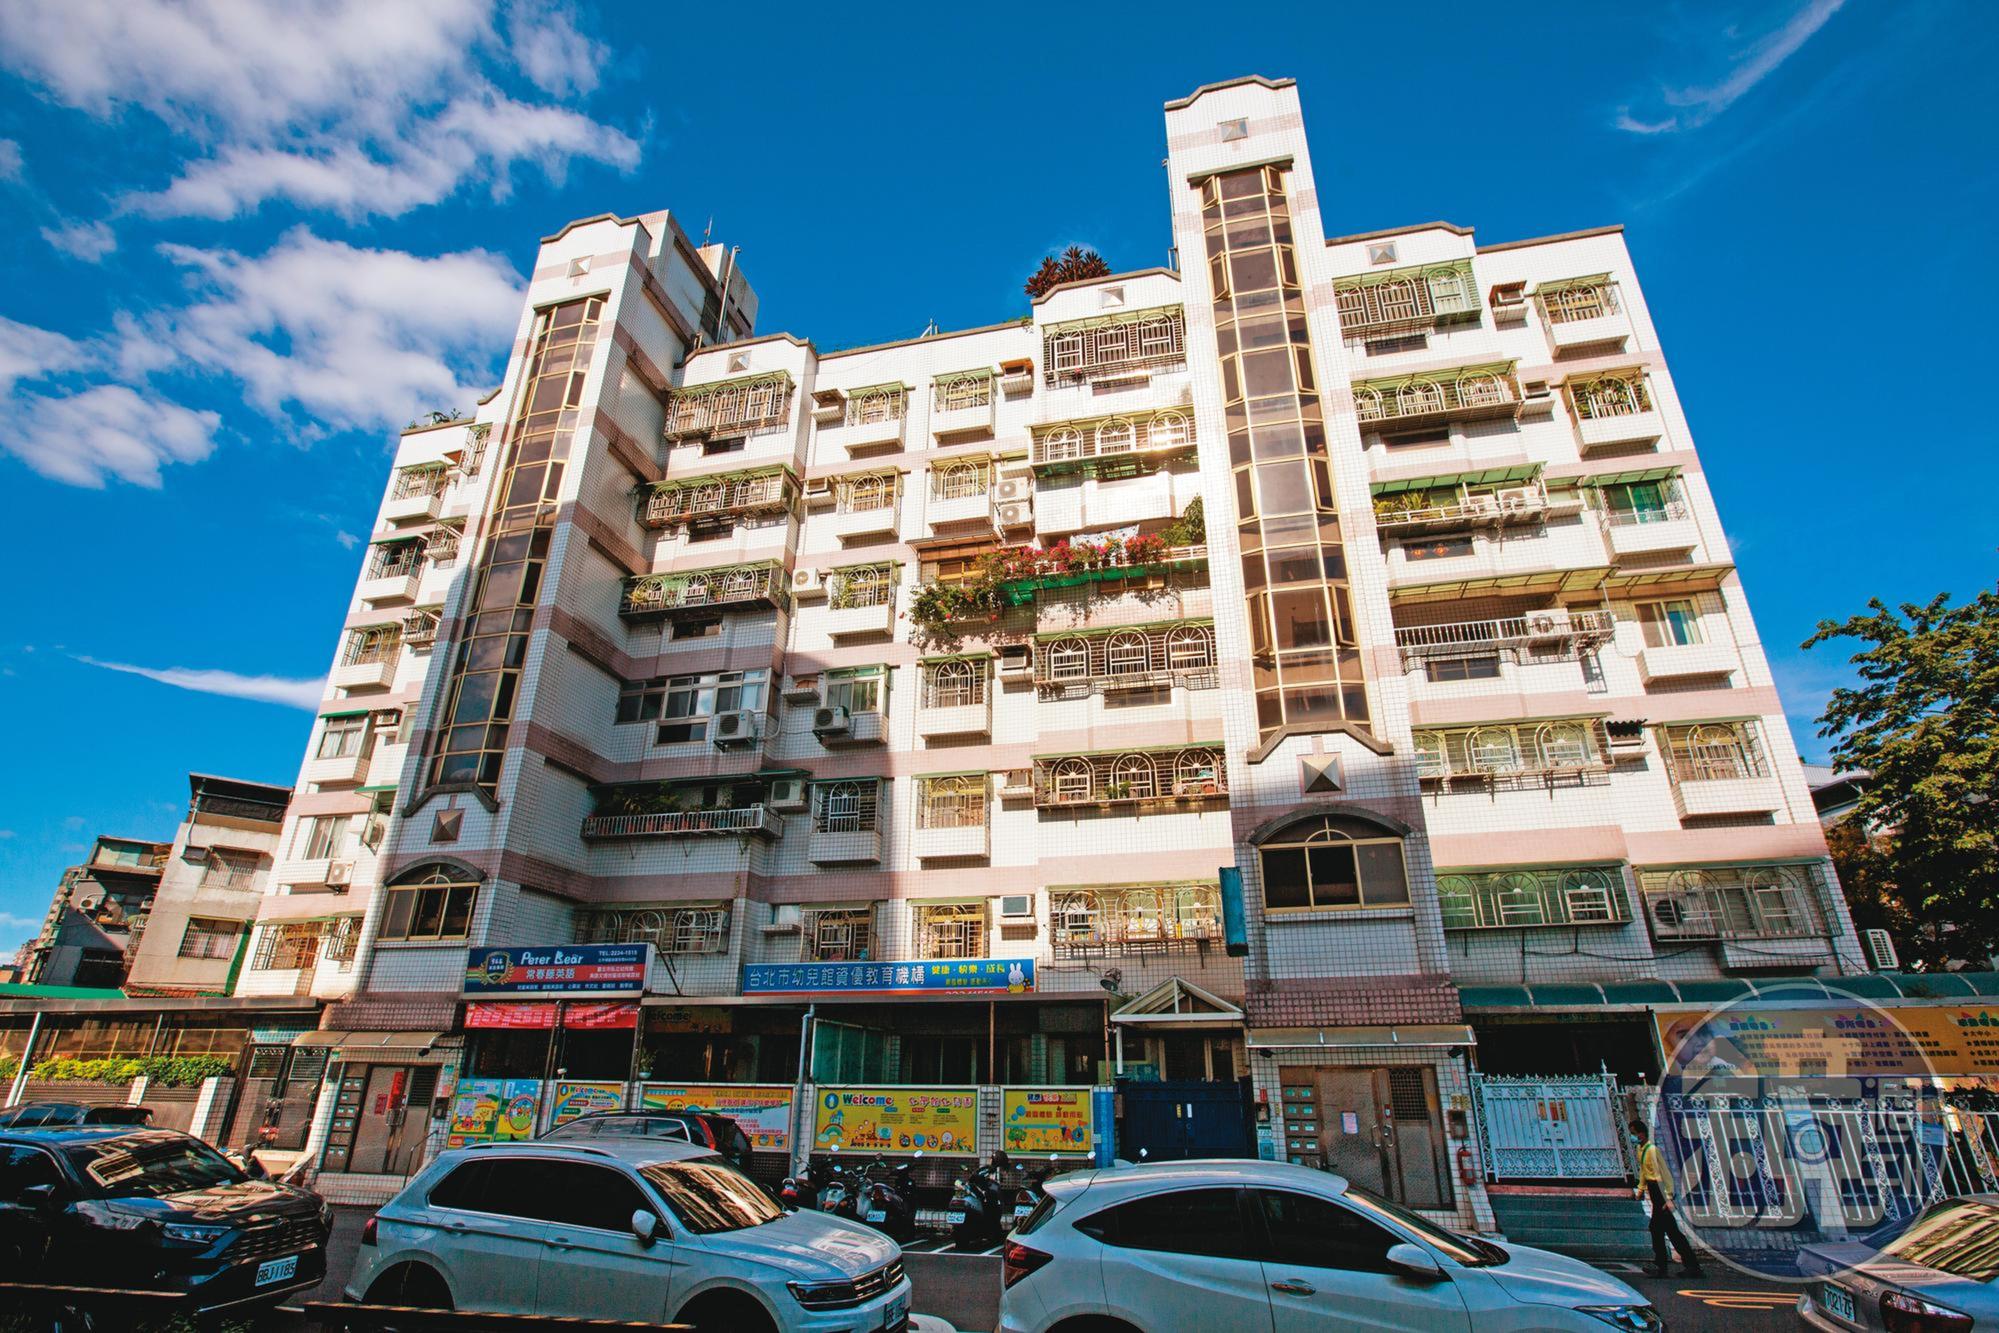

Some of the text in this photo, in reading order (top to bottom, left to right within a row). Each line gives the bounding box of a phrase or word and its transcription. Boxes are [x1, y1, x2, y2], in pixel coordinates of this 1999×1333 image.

[520, 951, 551, 965] Peter
[554, 950, 584, 965] Bear
[750, 965, 925, 986] 台北市幼兒館資優教育機構
[842, 1093, 894, 1106] Welcome
